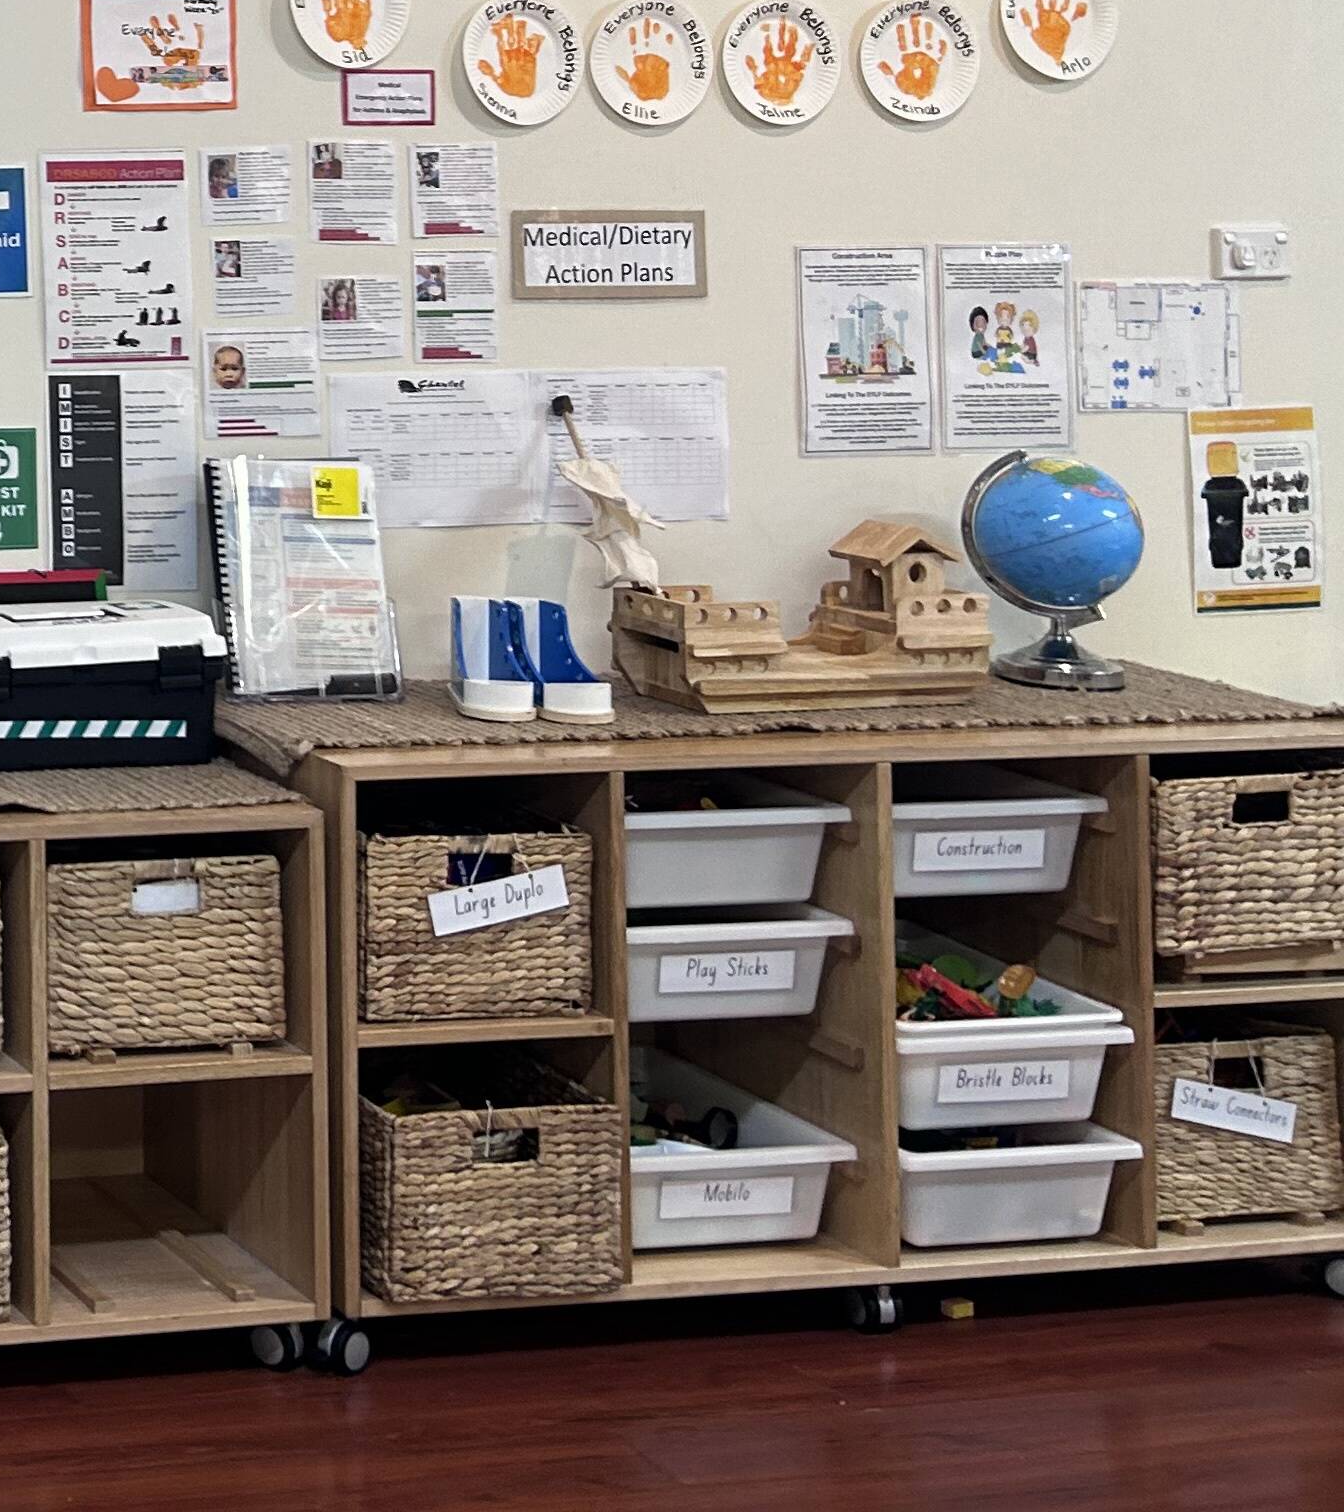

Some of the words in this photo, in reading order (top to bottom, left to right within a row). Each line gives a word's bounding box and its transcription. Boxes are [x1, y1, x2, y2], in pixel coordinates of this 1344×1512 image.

[604, 1, 675, 35] Everyone
[683, 19, 706, 79] Belongs
[342, 49, 373, 65] Sid
[1060, 56, 1092, 74] Arlo
[622, 102, 660, 119] Ellie
[119, 168, 154, 179] Action
[155, 167, 181, 179] Plan
[523, 224, 692, 250] Medical/Dietary
[546, 263, 613, 285] Action
[621, 262, 673, 283] Plans
[1, 505, 26, 518] KIT
[936, 837, 1022, 857] Construction
[454, 893, 496, 919] Large
[505, 883, 543, 909] Duplo
[686, 957, 717, 987] Play
[727, 956, 768, 978] Sticks
[956, 1068, 1001, 1089] Bristle
[1012, 1066, 1053, 1087] Blocks
[1180, 1086, 1219, 1111] Straw
[704, 1182, 751, 1202] Mobilo
